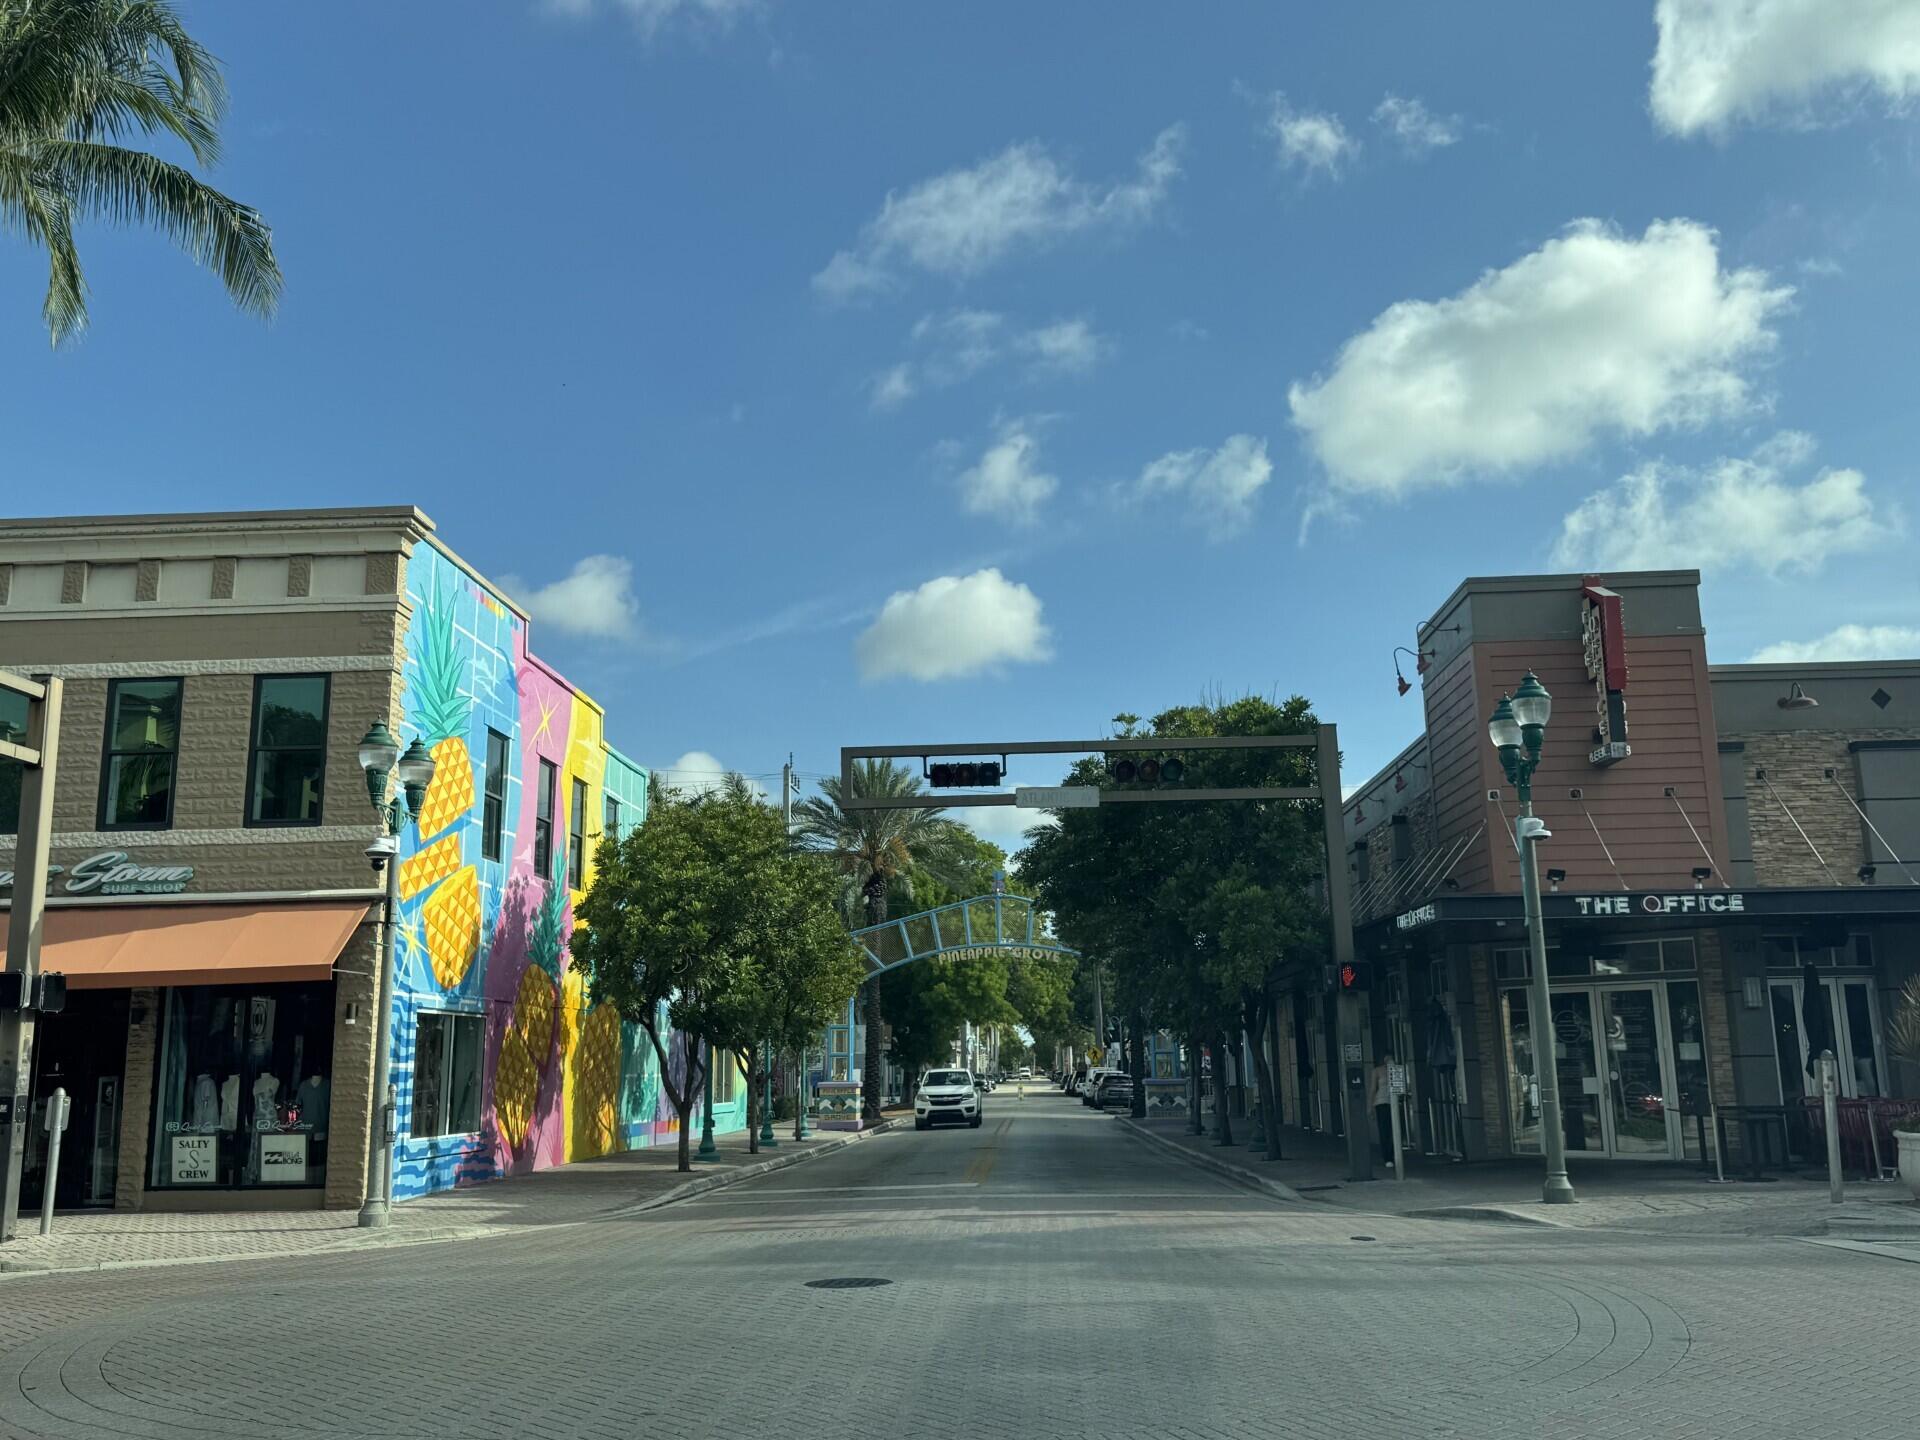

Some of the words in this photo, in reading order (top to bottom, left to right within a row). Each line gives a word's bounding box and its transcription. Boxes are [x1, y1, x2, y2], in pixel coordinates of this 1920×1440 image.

[65, 851, 194, 893] Storm
[100, 883, 138, 893] SURF
[144, 882, 187, 893] SHOP
[1575, 896, 1630, 914] THE
[1641, 894, 1745, 913] OFFICE
[938, 946, 1006, 965] PINEAPPLE
[1012, 947, 1061, 962] GROVE
[178, 1140, 210, 1149] SALTY
[189, 1149, 200, 1170] S
[178, 1170, 209, 1179] CREW
